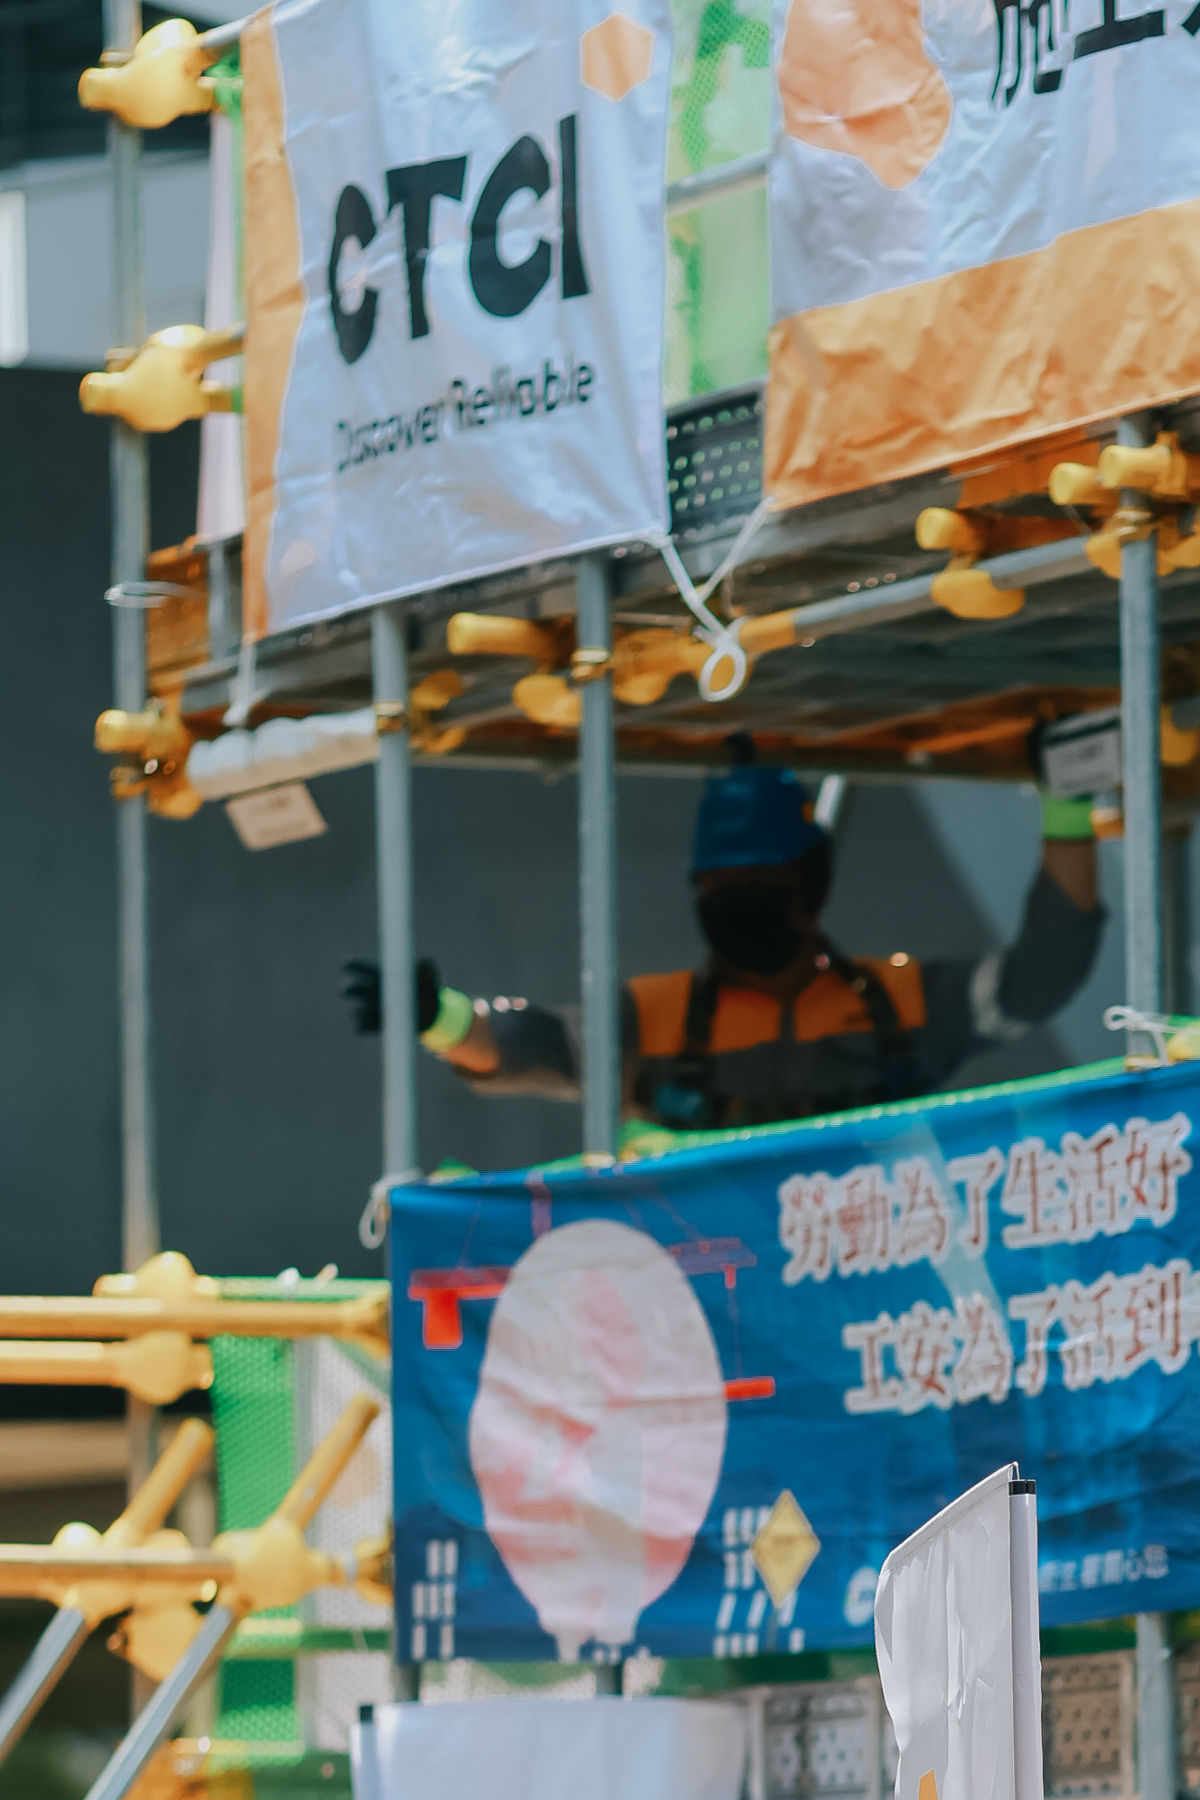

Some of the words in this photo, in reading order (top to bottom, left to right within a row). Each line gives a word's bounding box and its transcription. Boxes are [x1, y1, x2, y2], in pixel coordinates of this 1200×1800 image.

[328, 112, 591, 366] CTCI
[452, 356, 593, 429] Reliable
[782, 1114, 1189, 1283] 勞動為了生活好
